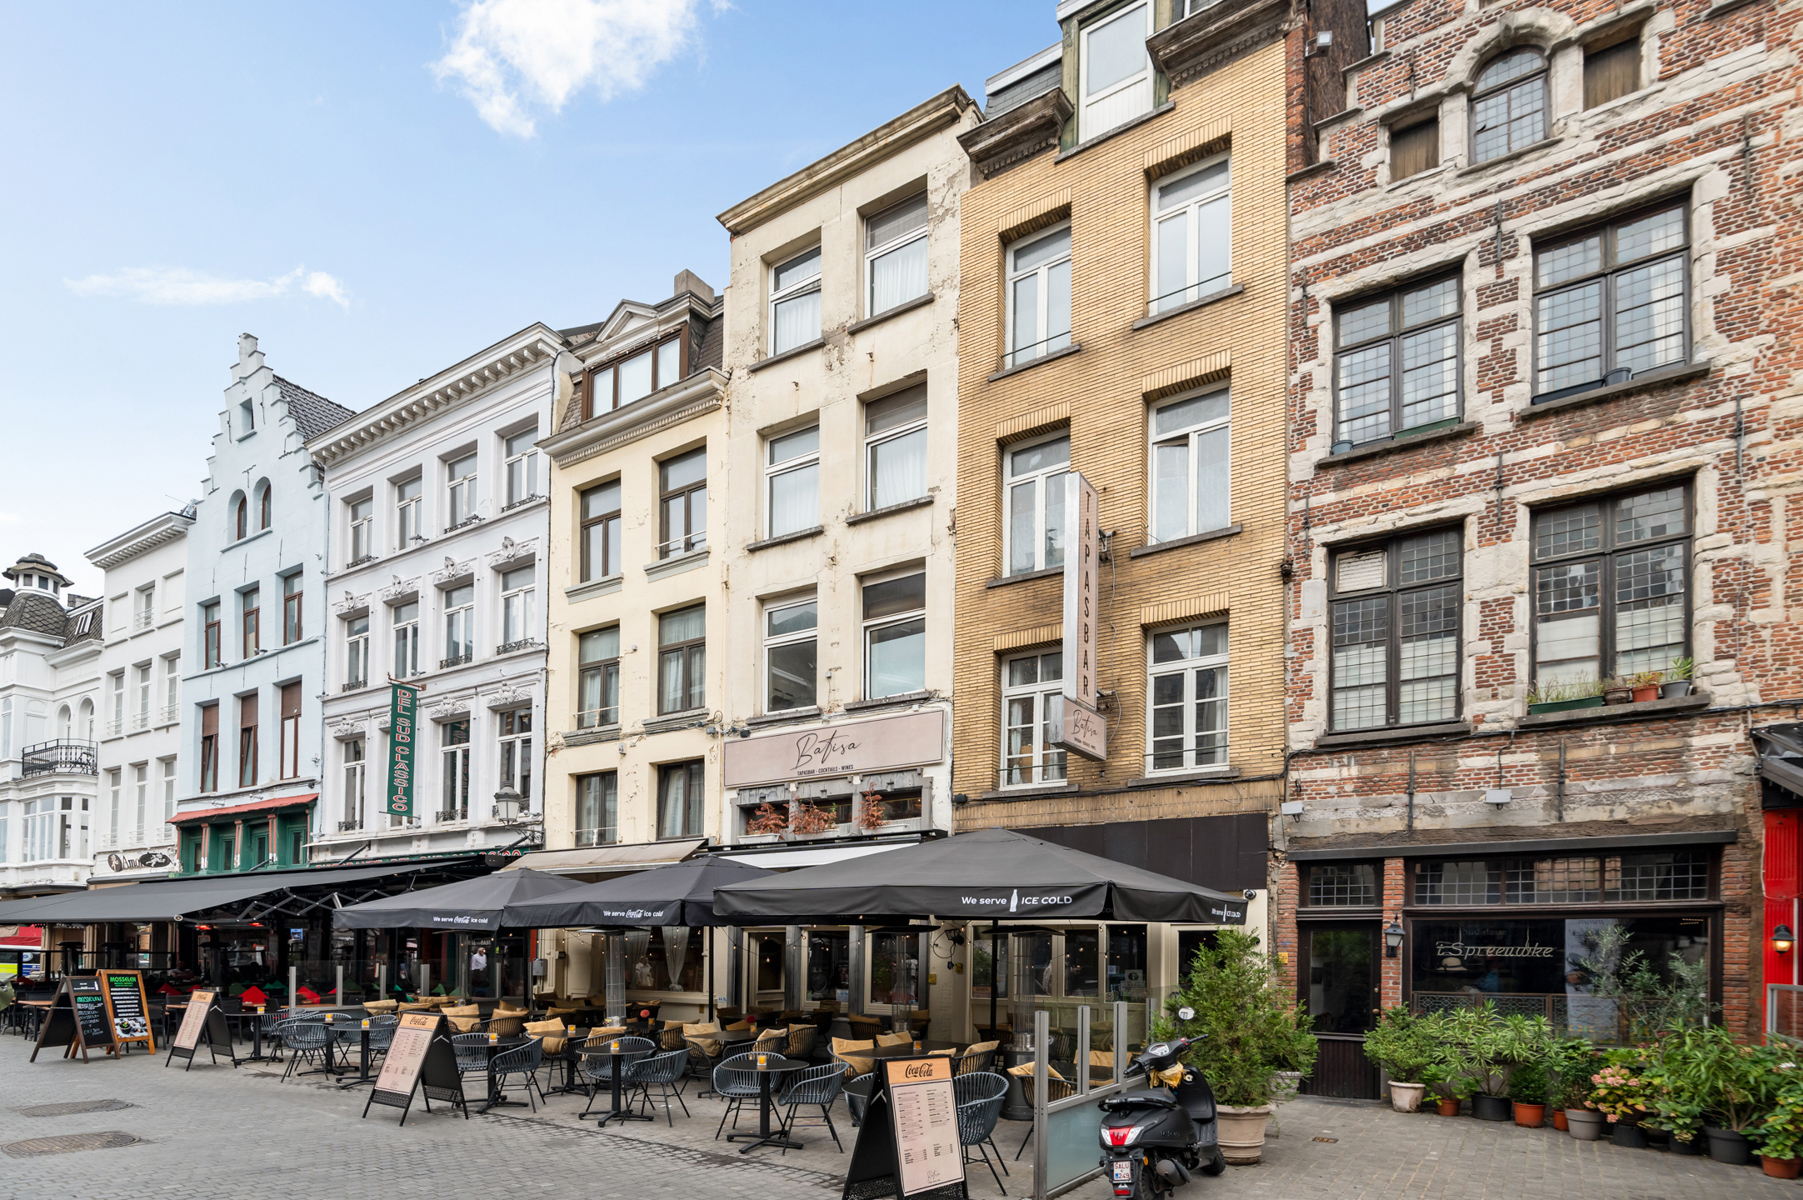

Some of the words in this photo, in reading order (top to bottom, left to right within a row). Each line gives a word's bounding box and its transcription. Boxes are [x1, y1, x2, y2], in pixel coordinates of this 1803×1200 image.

[1083, 491, 1092, 697] TAPASBAR
[397, 688, 412, 715] DEL
[395, 717, 411, 742] SUD
[790, 730, 861, 771] Batisa
[392, 745, 410, 812] CLASSICO
[961, 896, 977, 904] We
[979, 897, 1007, 905] serve
[1021, 896, 1039, 904] ICE
[1041, 896, 1073, 904] COLD
